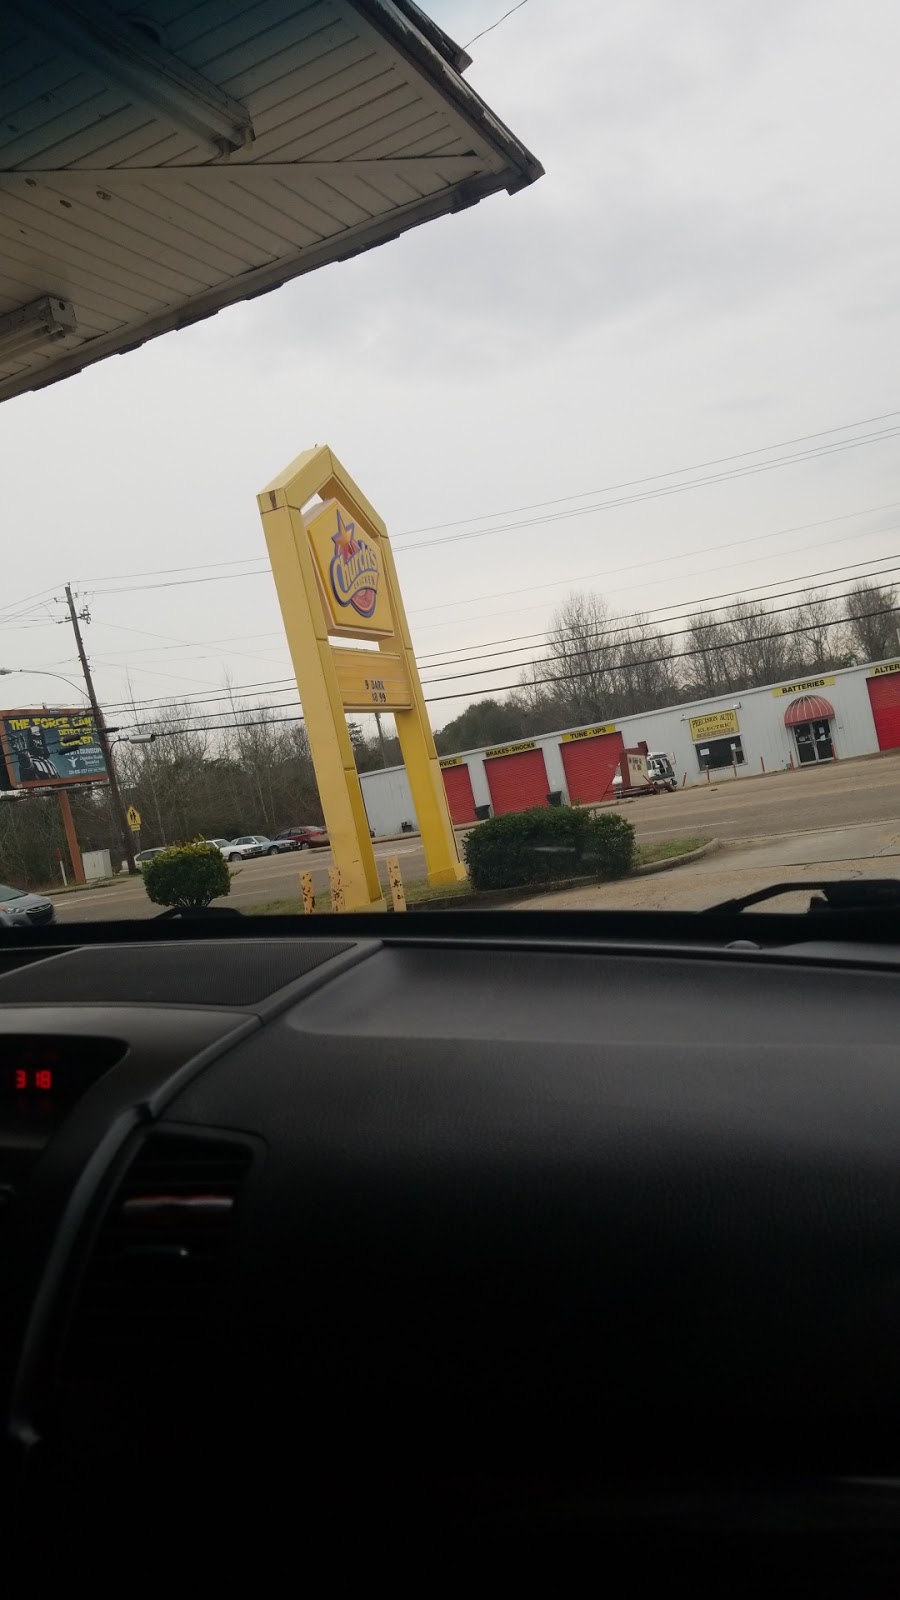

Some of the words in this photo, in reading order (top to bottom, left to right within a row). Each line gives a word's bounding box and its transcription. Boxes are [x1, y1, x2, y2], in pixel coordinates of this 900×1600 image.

[353, 575, 376, 590] CHICKEN
[782, 679, 826, 694] BATTERIES
[9, 718, 31, 731] THE
[32, 717, 71, 729] FORCE
[691, 715, 718, 729] PRECISION
[719, 712, 734, 721] AUTO
[697, 722, 732, 733] ELECTRIC
[58, 728, 81, 736] DETECT
[570, 730, 588, 739] TUNE
[593, 726, 607, 735] UPS
